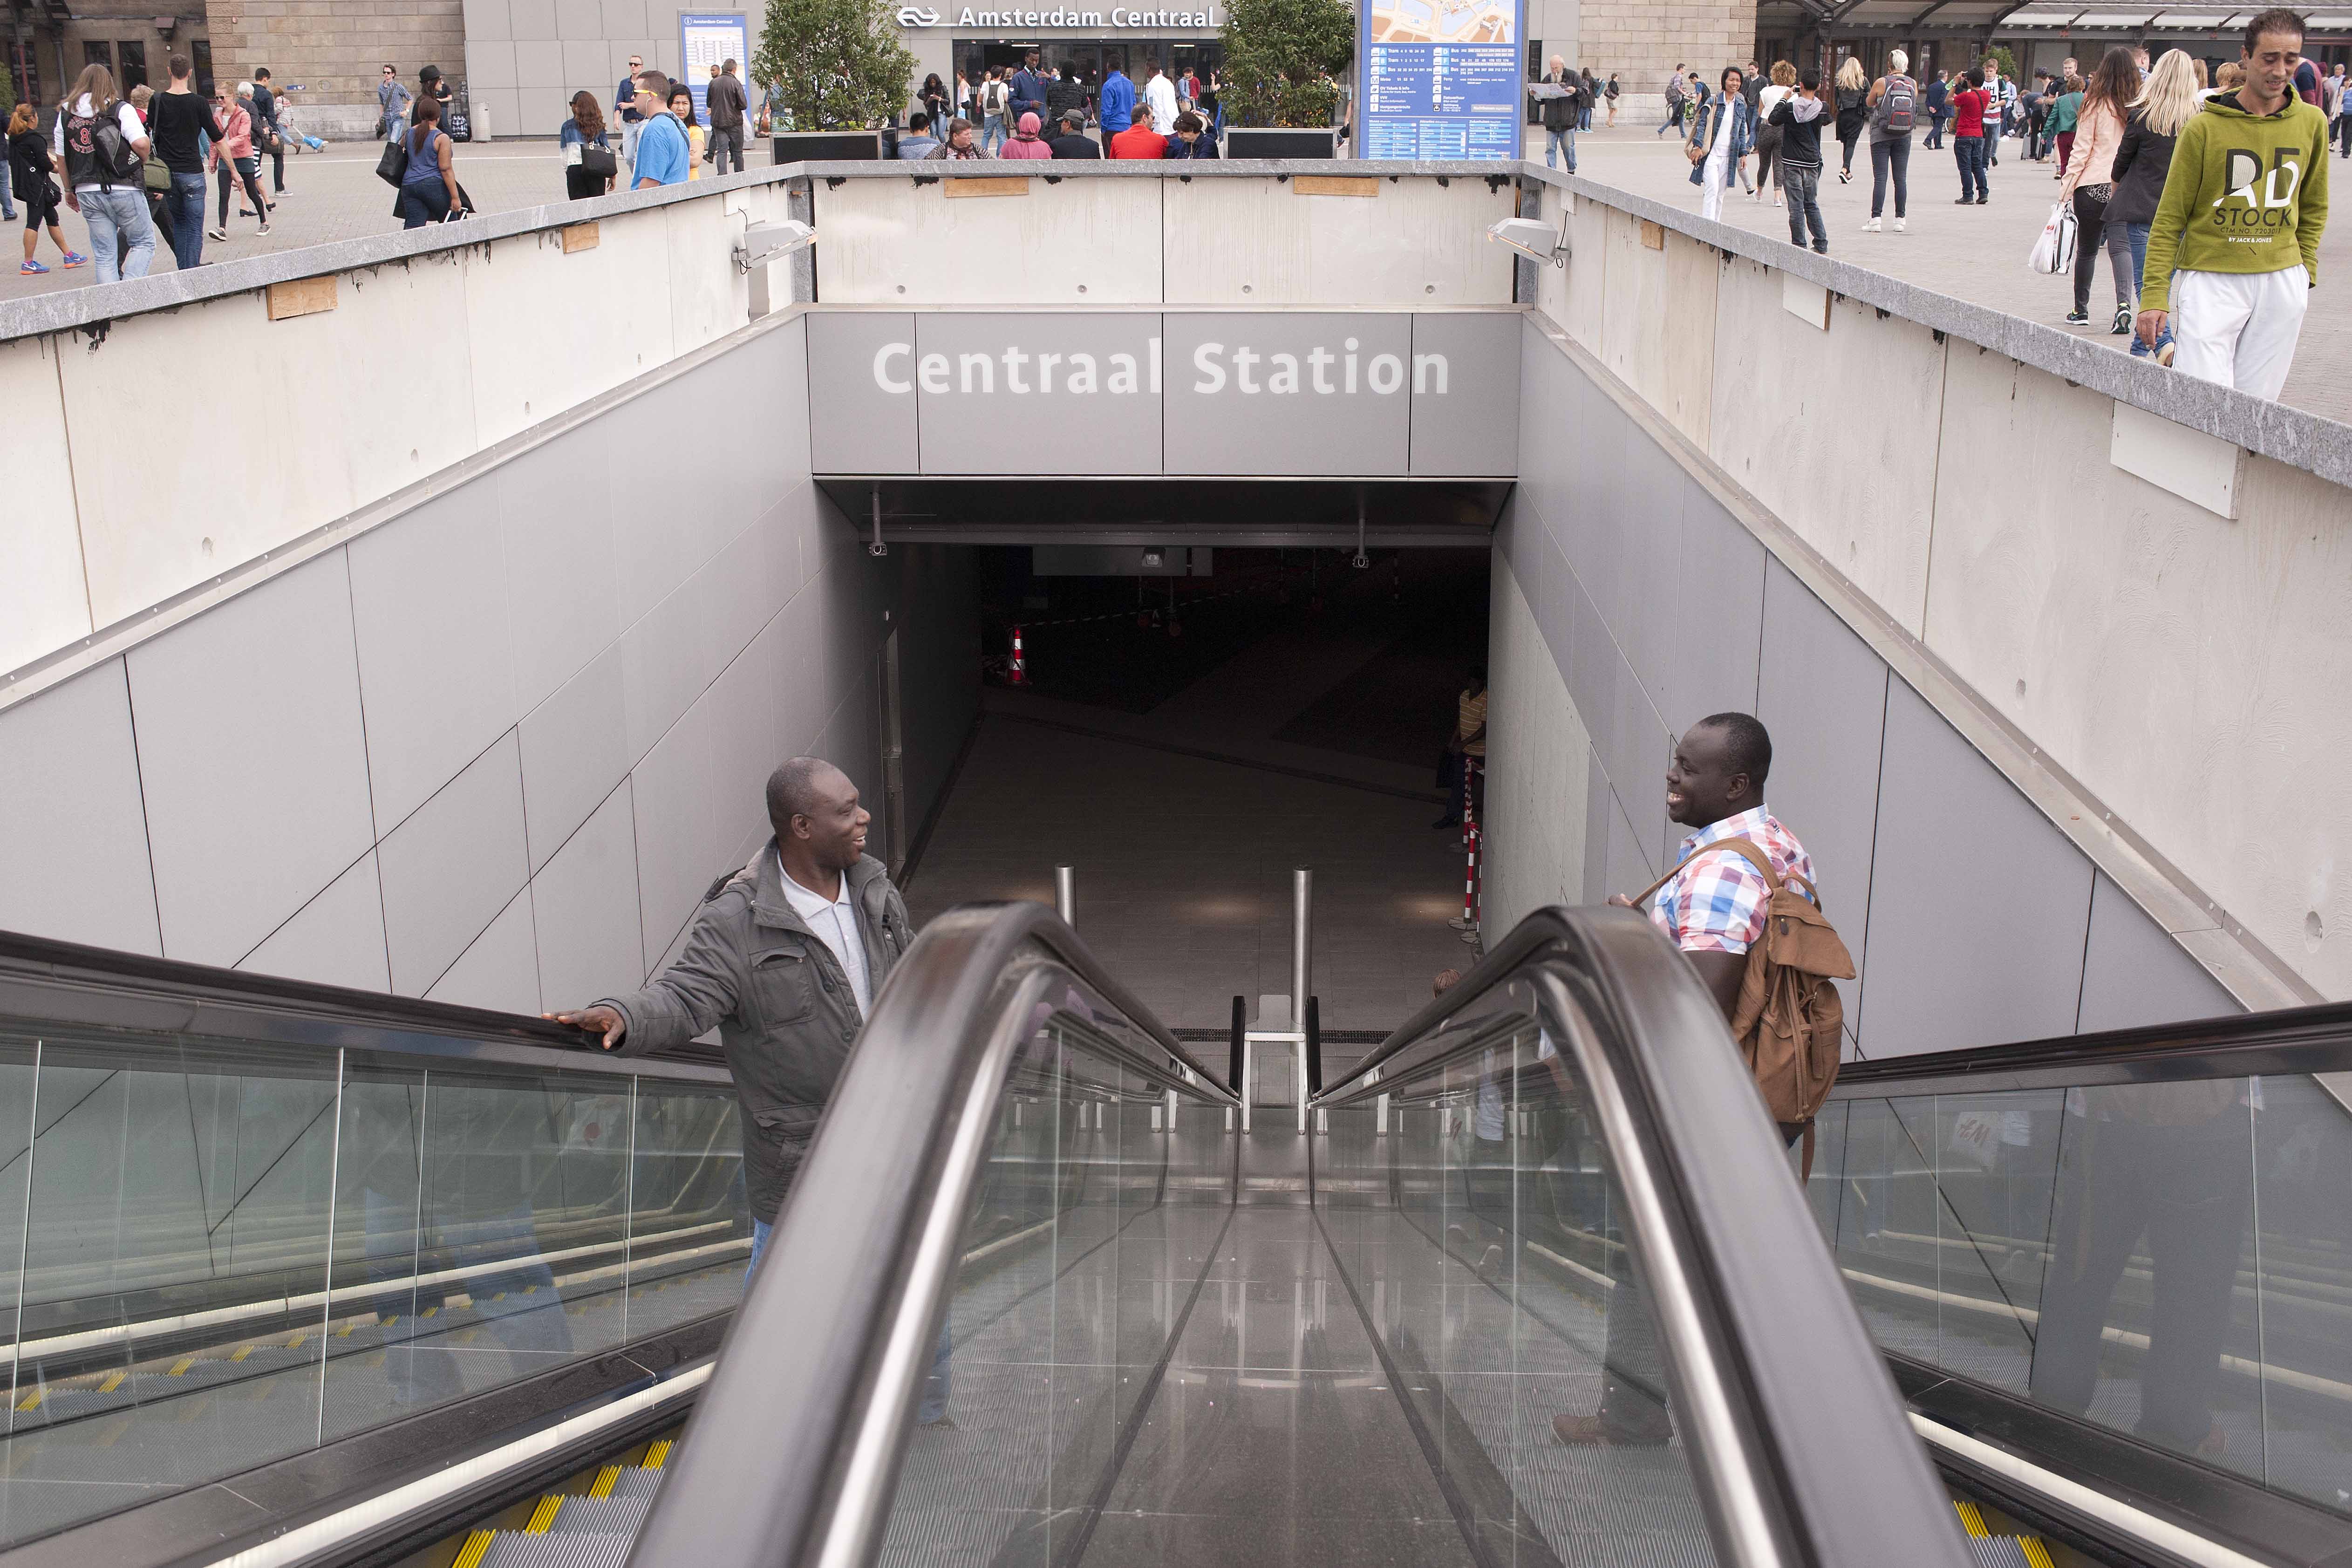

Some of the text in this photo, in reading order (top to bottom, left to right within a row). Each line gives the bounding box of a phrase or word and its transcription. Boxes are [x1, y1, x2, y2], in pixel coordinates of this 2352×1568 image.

[958, 6, 1213, 27] Amsterdam Centraal
[2213, 208, 2292, 226] STOCK
[873, 337, 1448, 395] Centraal Station
